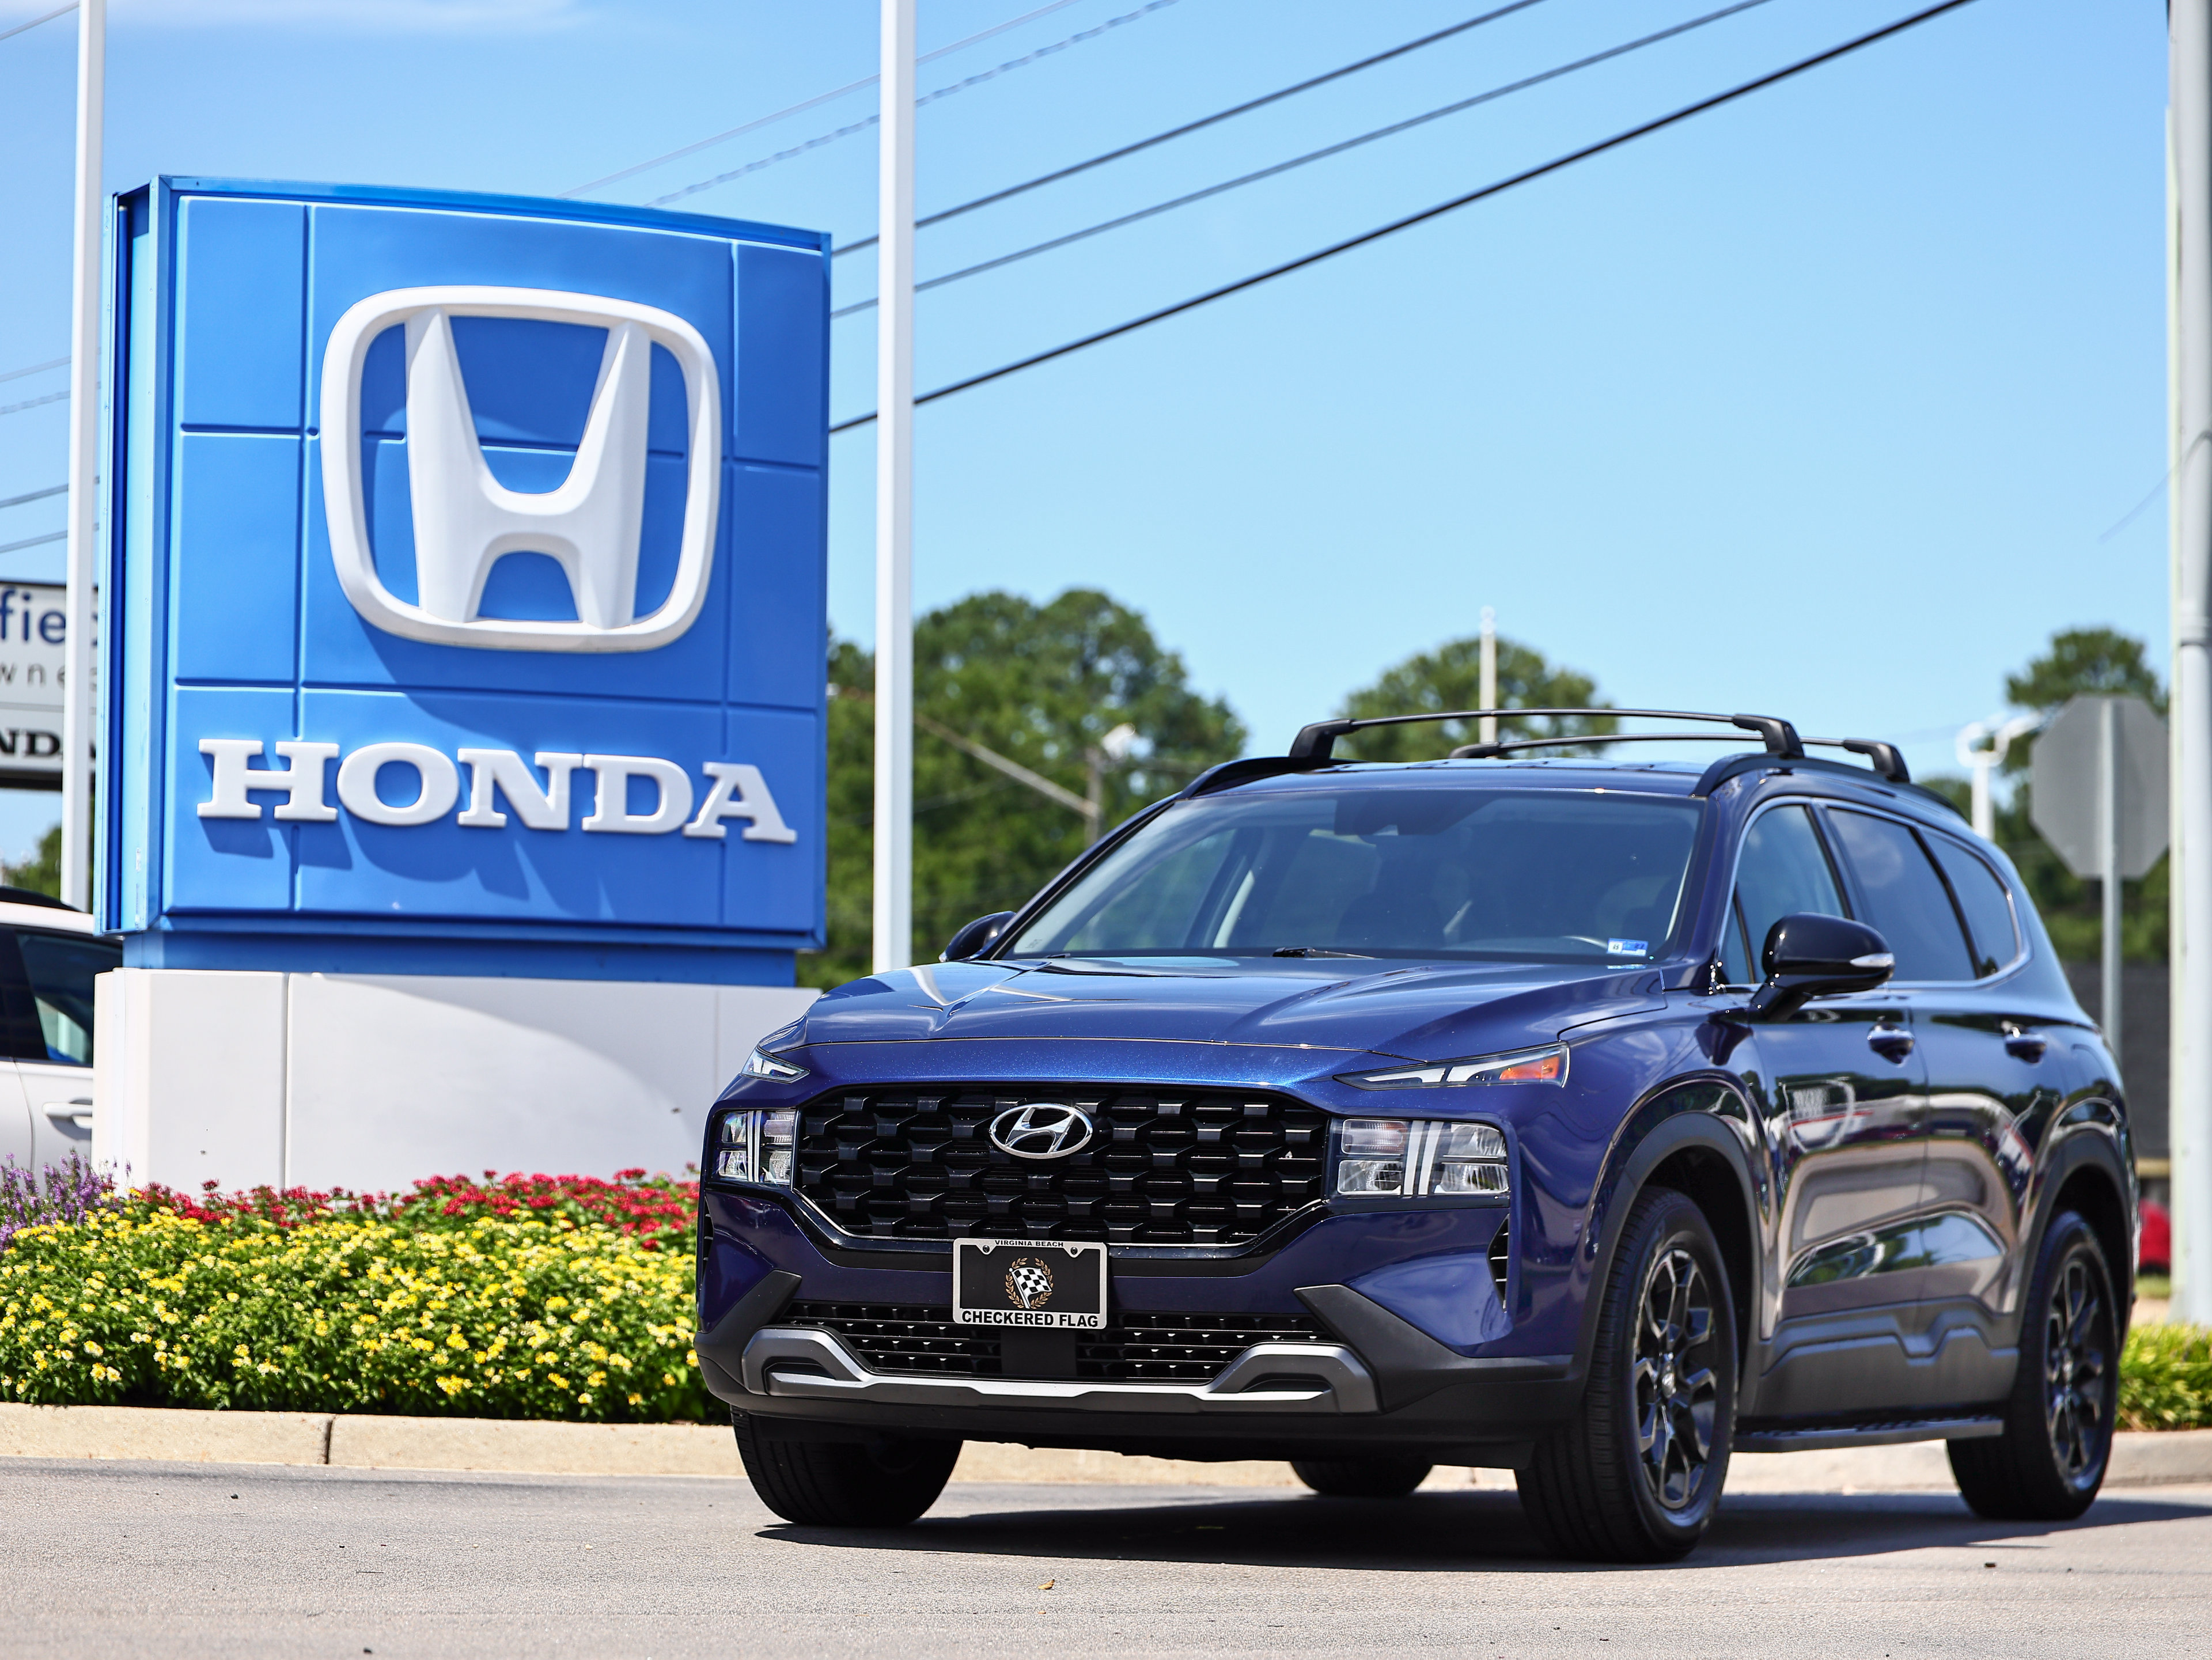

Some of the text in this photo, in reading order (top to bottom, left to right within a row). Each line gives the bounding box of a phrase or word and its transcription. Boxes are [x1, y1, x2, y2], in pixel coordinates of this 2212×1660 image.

[197, 738, 797, 843] HONDA
[961, 1310, 1099, 1328] CHECKERED FLAG
